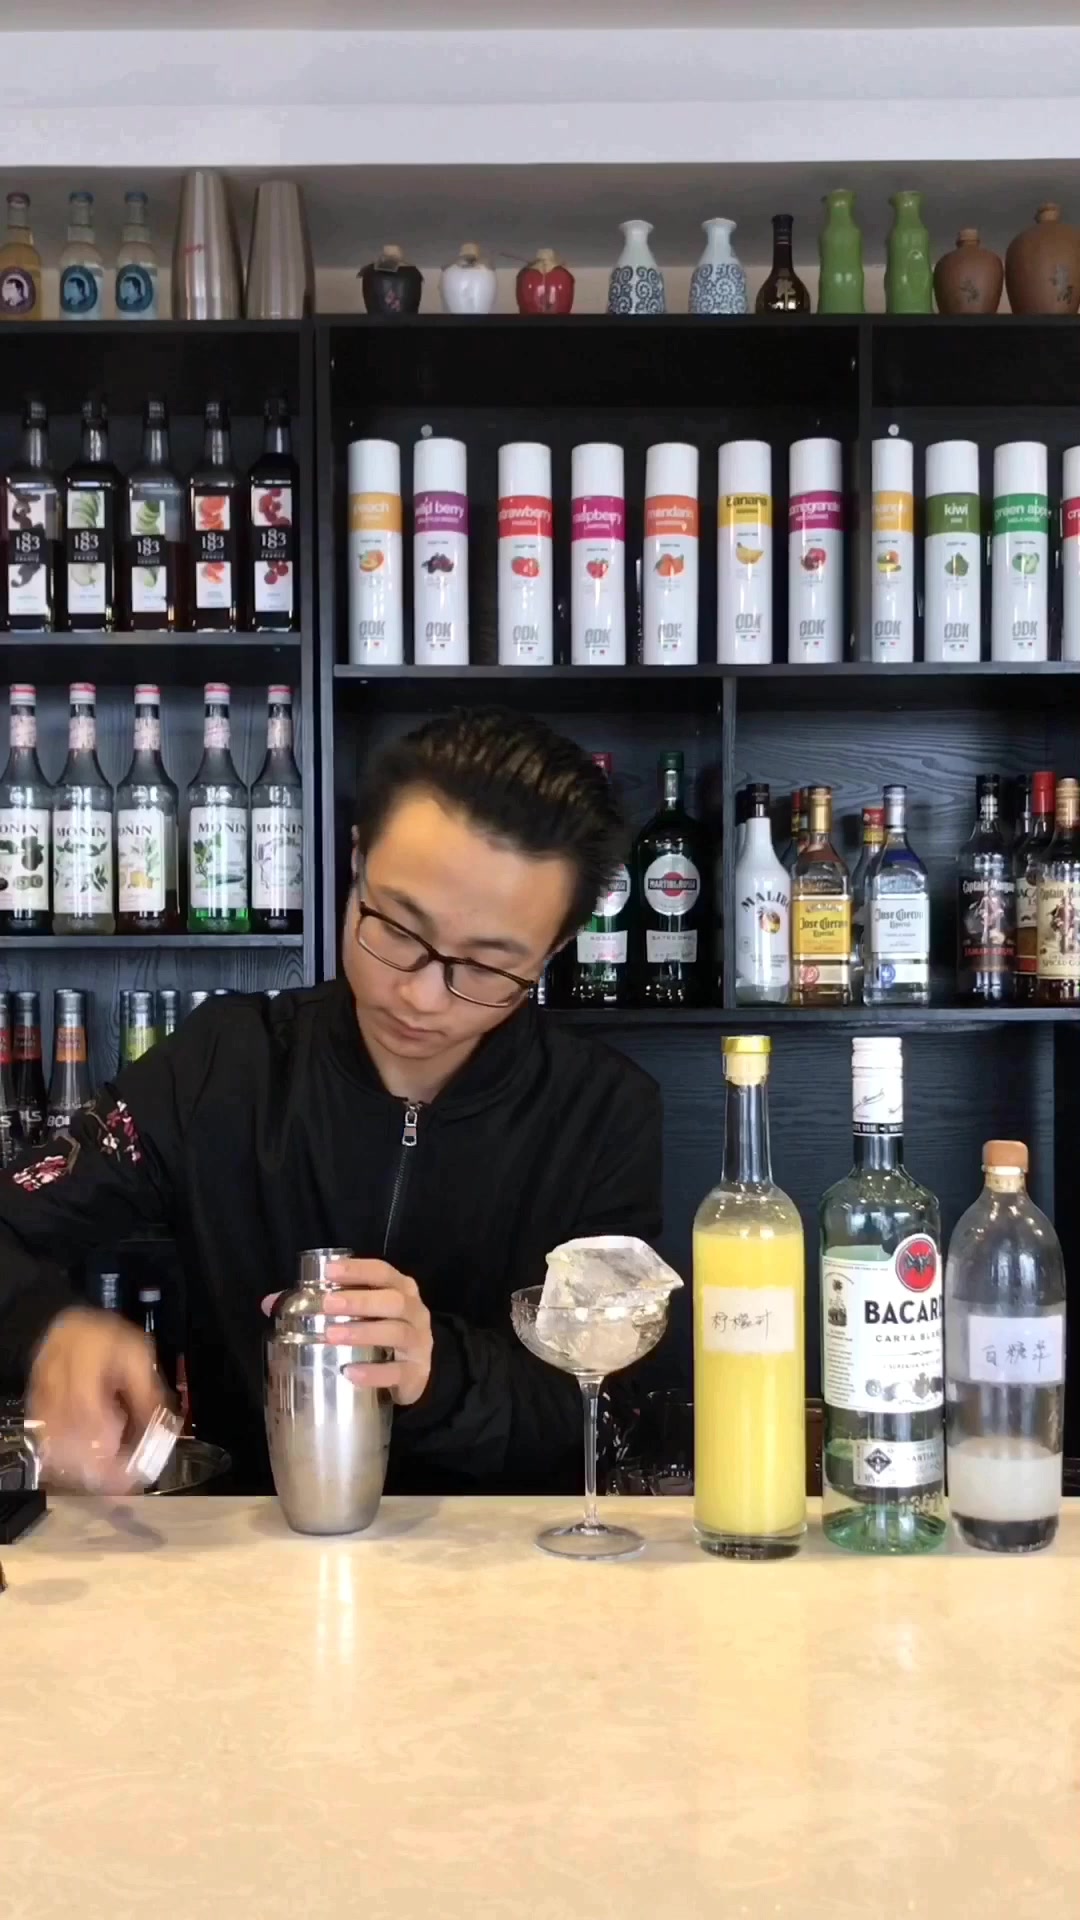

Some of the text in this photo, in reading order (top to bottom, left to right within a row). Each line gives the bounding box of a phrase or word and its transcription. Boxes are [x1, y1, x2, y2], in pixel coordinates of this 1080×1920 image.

[435, 500, 464, 519] berry
[944, 503, 968, 516] kiwi
[875, 1335, 916, 1344] CARTA
